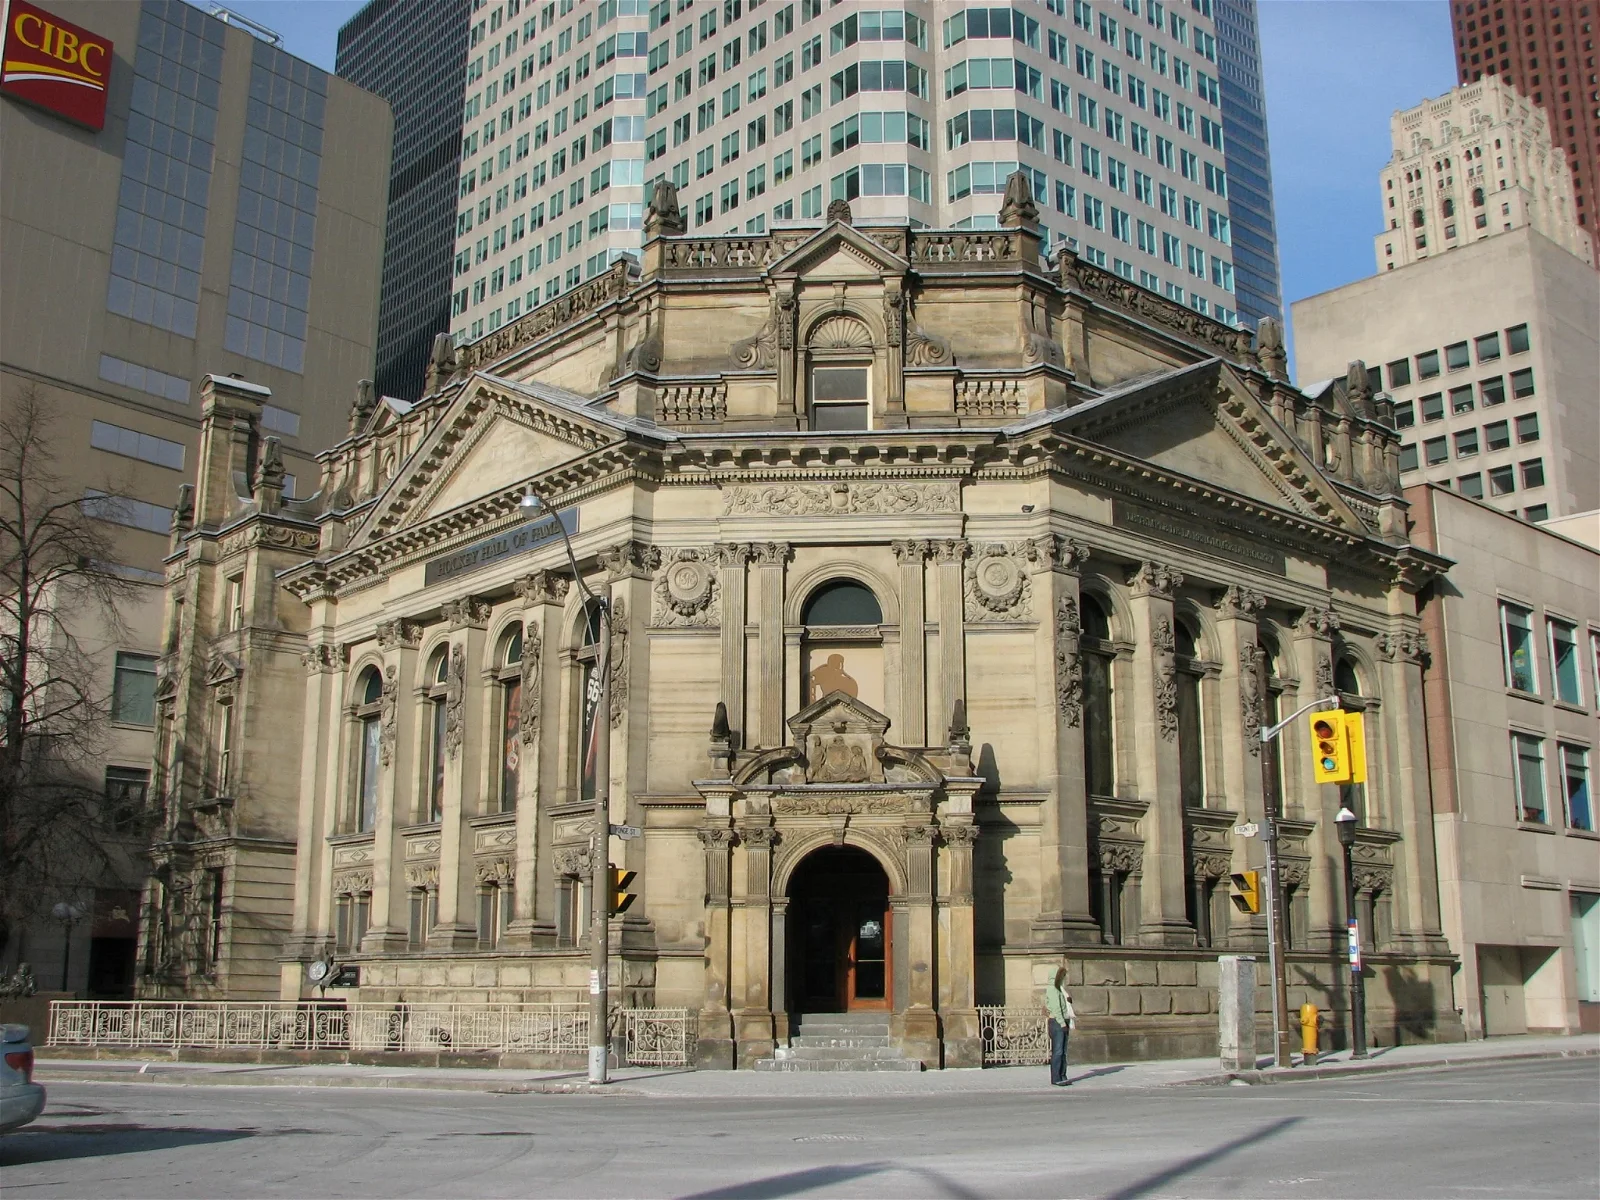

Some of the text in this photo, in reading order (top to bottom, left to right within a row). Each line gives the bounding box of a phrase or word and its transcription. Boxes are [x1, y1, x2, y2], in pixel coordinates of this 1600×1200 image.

[14, 13, 105, 77] CIBC
[437, 520, 563, 577] HOCKEY HALL OF FAME
[615, 826, 629, 835] YONGE
